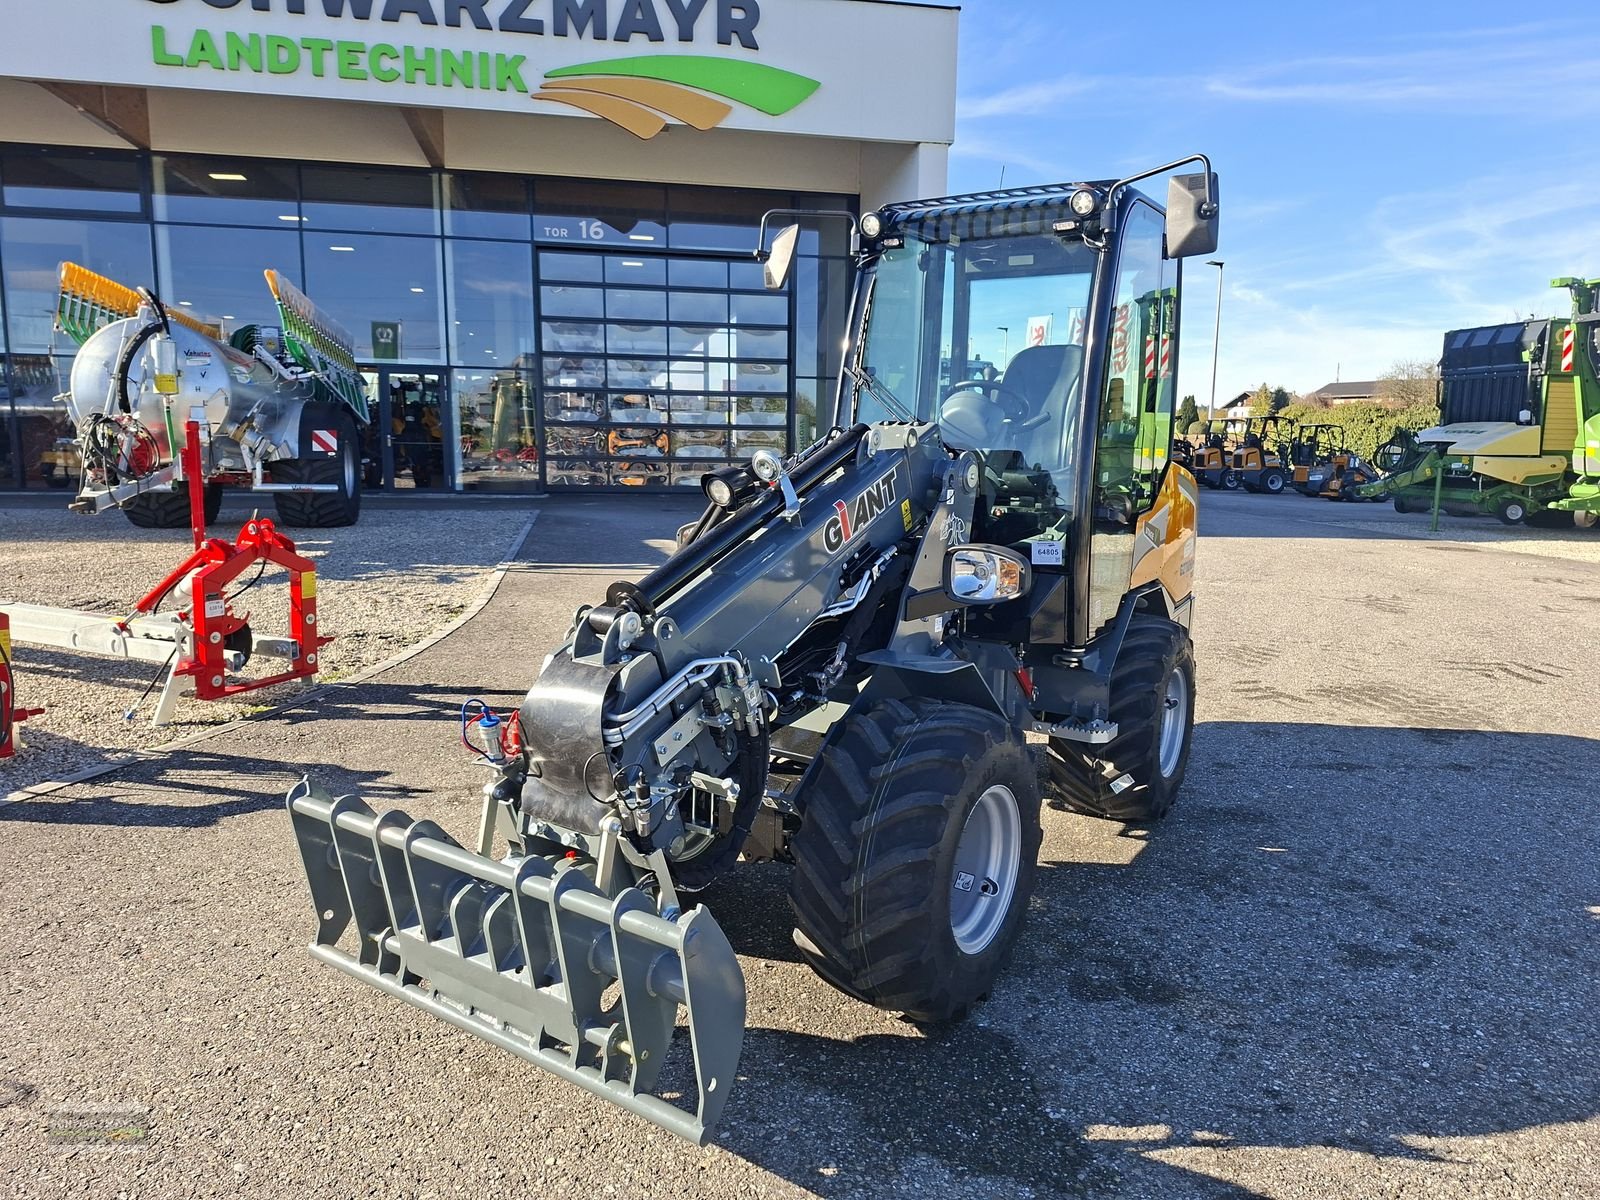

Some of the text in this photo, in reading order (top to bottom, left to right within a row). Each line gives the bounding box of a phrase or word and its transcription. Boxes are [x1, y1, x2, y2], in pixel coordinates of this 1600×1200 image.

[150, 0, 759, 50] ARZMAYR
[151, 25, 528, 93] LANDTECHNIK
[544, 220, 604, 240] TOR 16
[823, 466, 897, 555] GIANT
